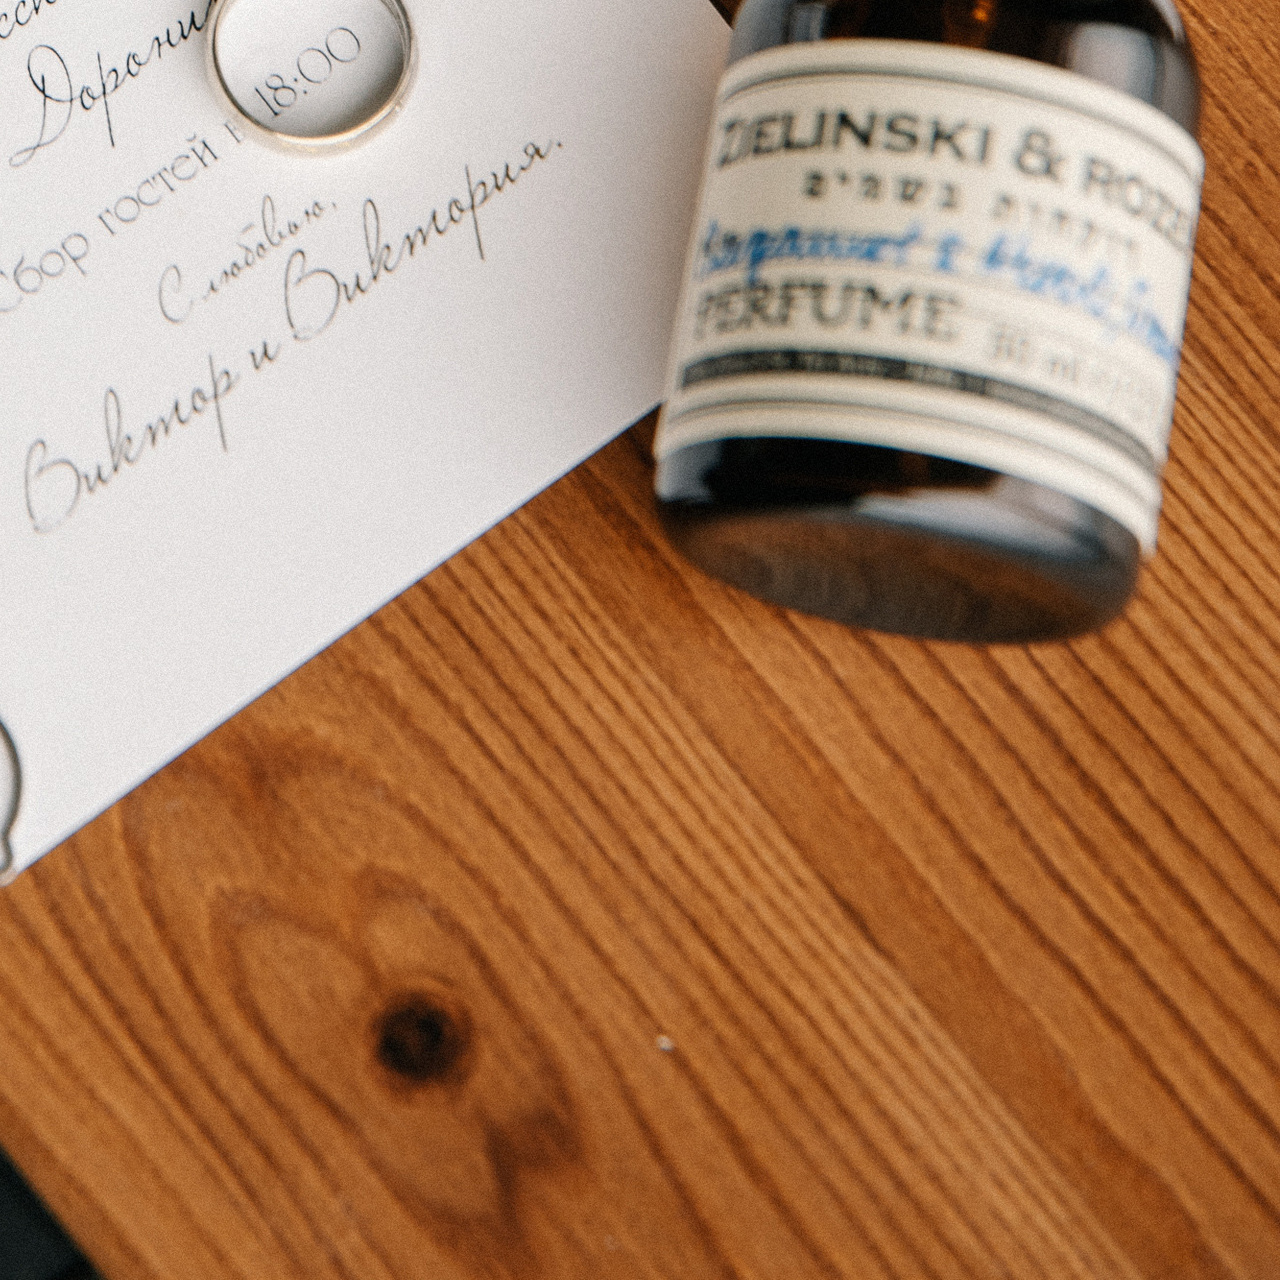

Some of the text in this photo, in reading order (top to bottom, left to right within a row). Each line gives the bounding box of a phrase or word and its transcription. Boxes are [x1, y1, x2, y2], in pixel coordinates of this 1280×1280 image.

[98, 136, 220, 237] гостей
[254, 26, 362, 117] 18:00
[1013, 124, 1064, 182] &
[23, 351, 241, 535] Виктор
[248, 339, 283, 371] и
[284, 139, 564, 342] Виктория.
[694, 277, 962, 341] PERFUME
